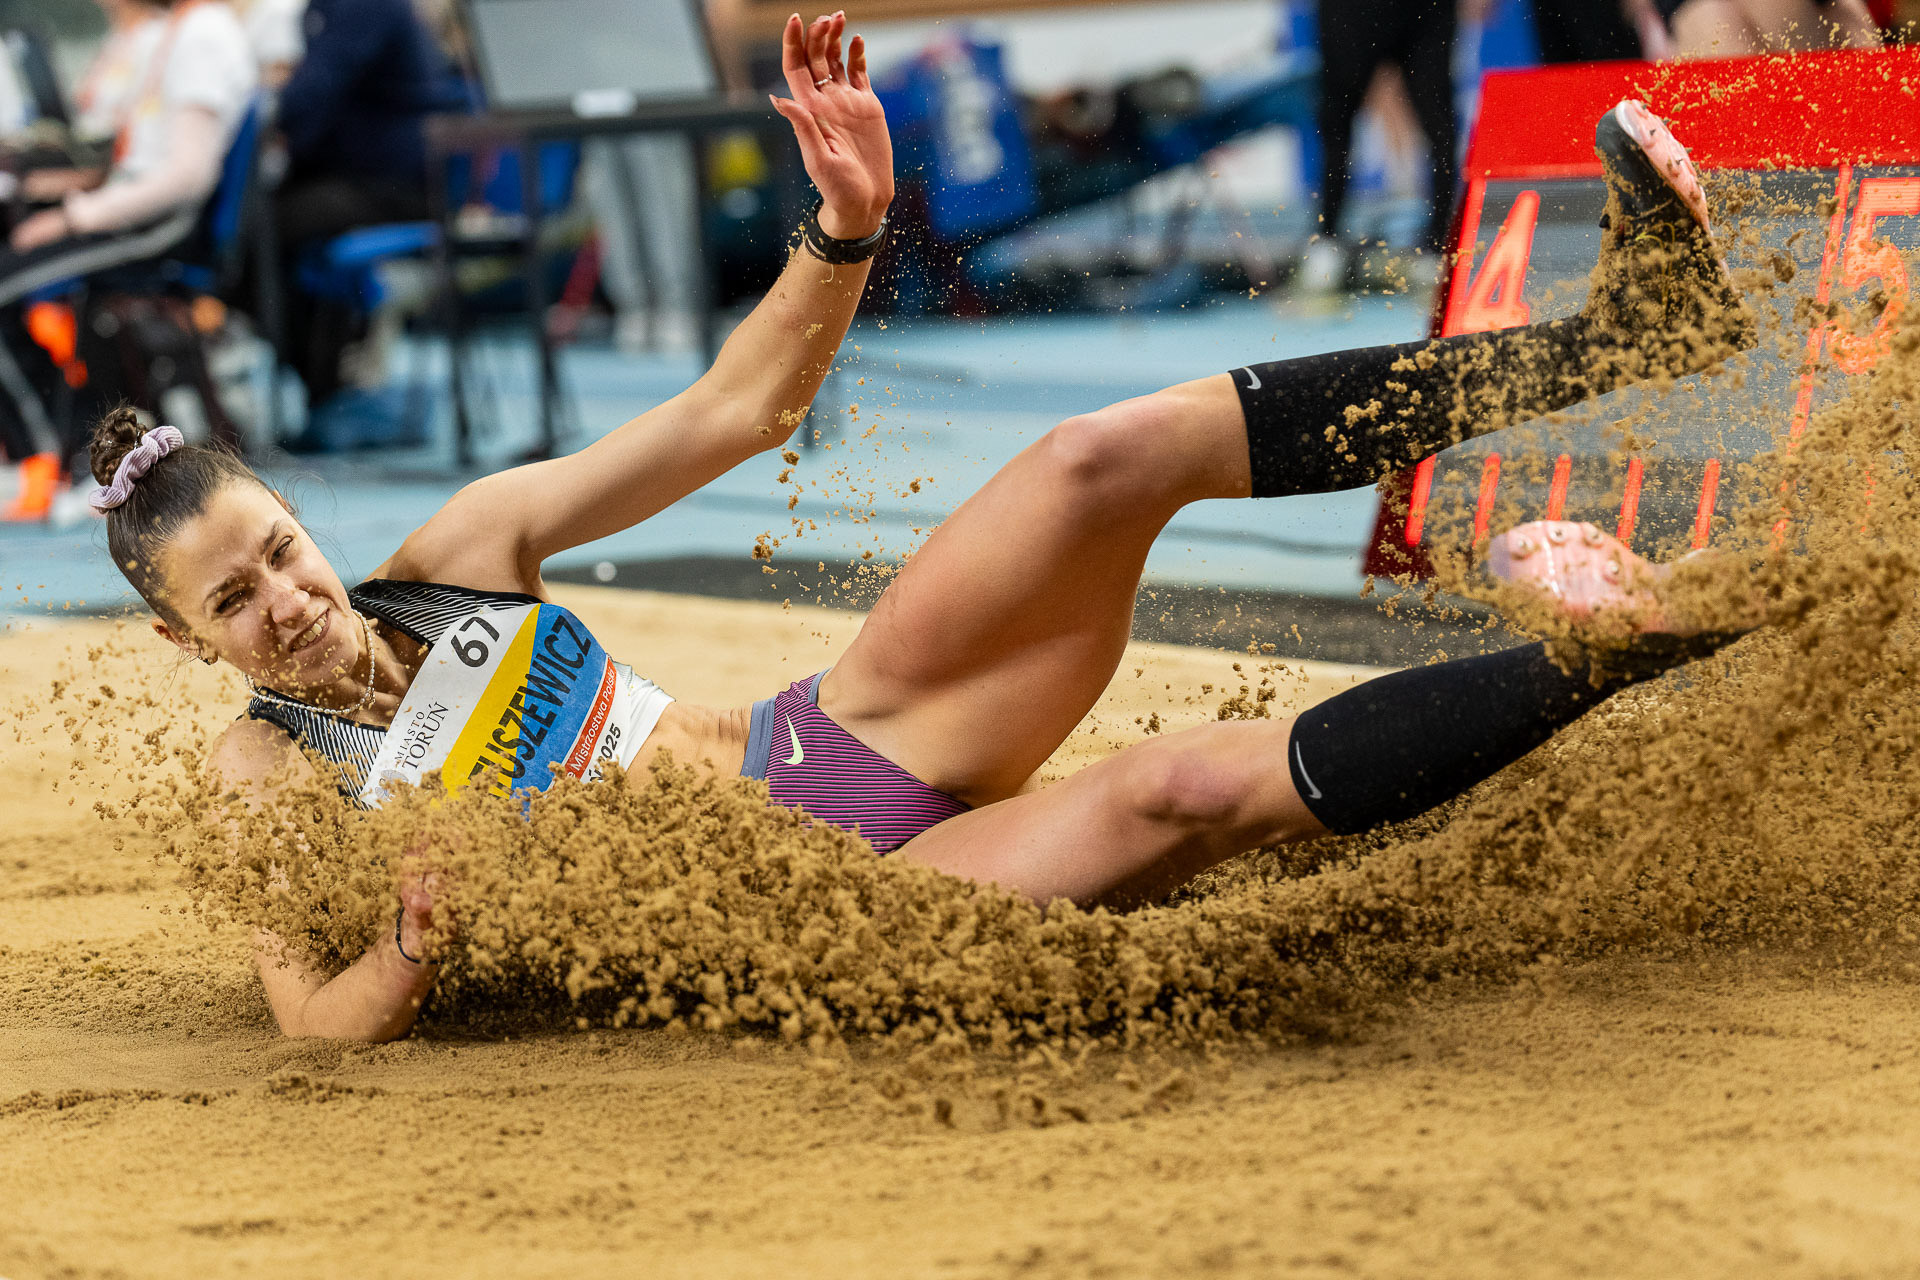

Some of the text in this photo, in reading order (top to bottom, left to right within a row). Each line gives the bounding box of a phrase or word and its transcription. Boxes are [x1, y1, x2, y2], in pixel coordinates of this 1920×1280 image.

[1825, 177, 1920, 376] 5
[451, 616, 500, 668] 67
[394, 711, 425, 761] MIASTO
[401, 701, 449, 770] TORUŃ
[569, 700, 608, 772] Mistrzostwa
[602, 666, 616, 702] Polski
[597, 722, 621, 763] 025
